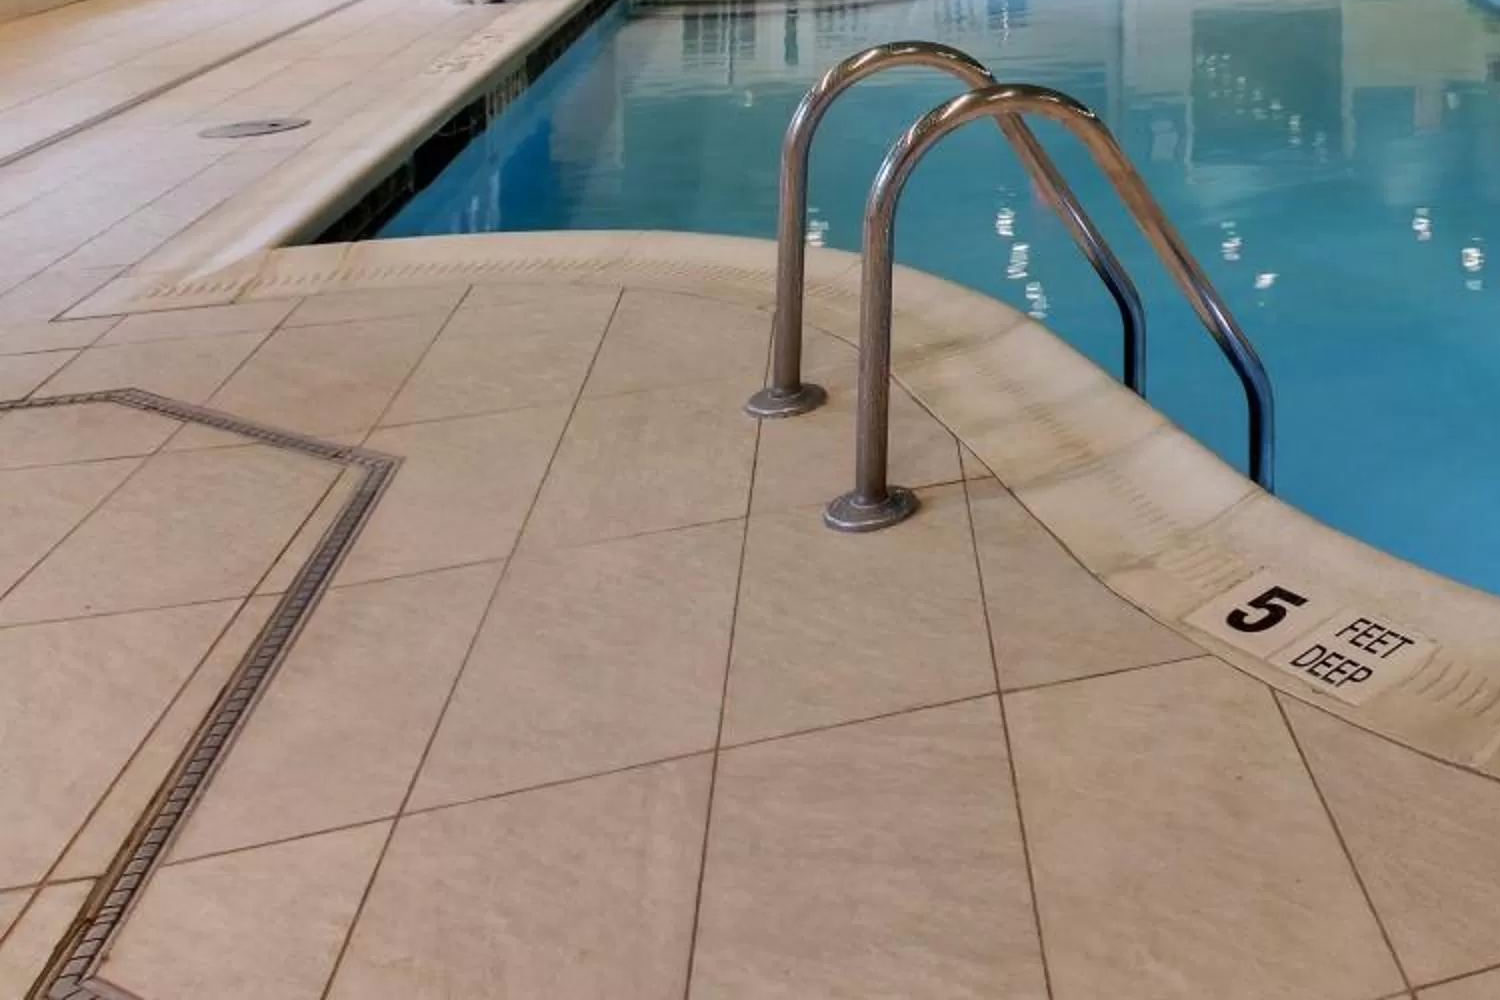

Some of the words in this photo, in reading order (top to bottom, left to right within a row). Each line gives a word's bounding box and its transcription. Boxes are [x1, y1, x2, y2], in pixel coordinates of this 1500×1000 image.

[1225, 585, 1310, 633] 5
[1334, 617, 1415, 659] FEET
[1289, 643, 1374, 688] DEEP
